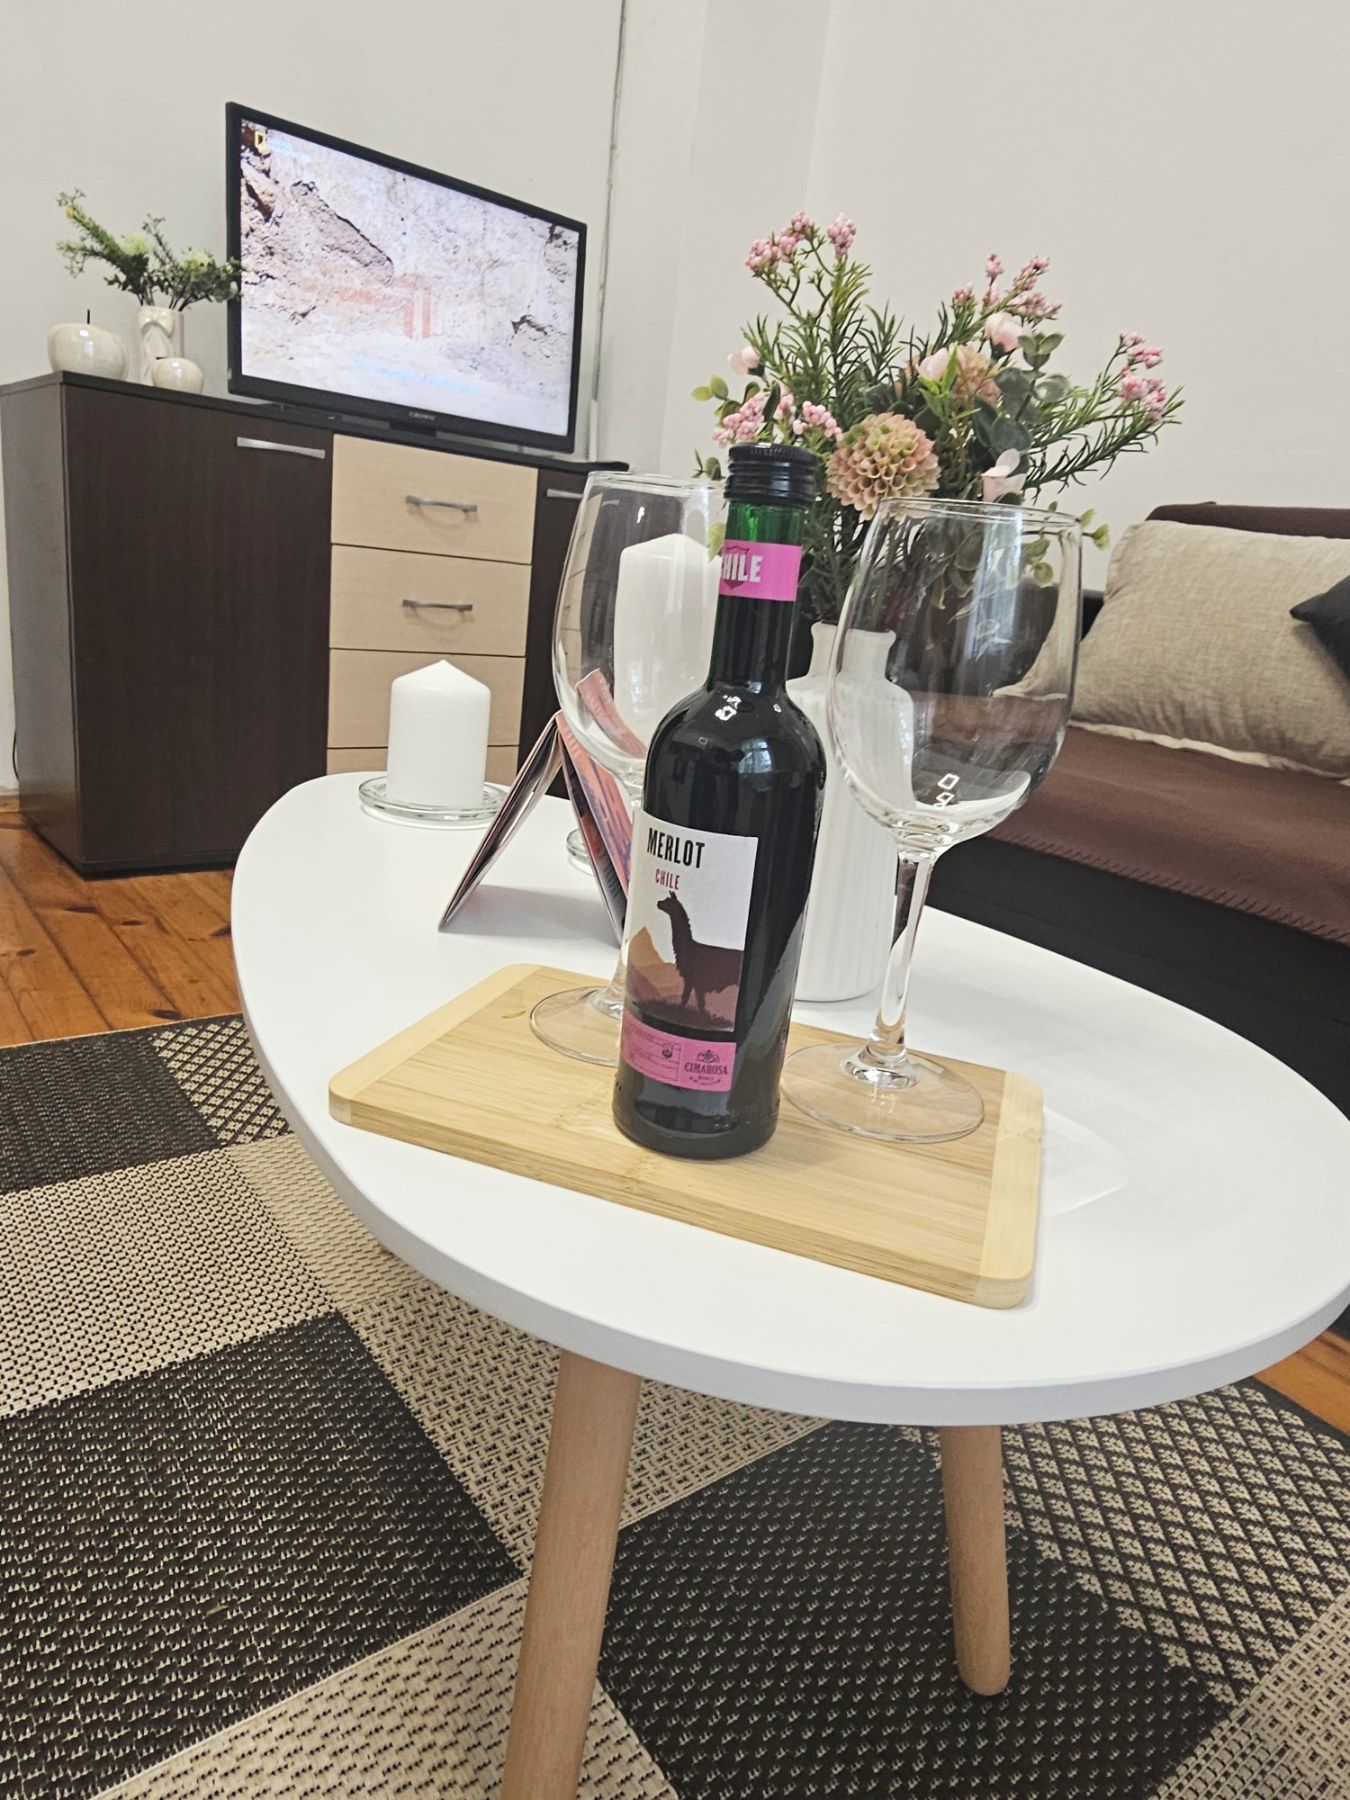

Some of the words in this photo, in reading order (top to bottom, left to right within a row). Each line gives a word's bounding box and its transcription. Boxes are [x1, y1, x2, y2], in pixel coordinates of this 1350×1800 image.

[721, 552, 764, 583] HILE
[647, 827, 705, 868] MERLOT
[655, 868, 680, 890] CHILE
[684, 1062, 728, 1075] CIMAROSA
